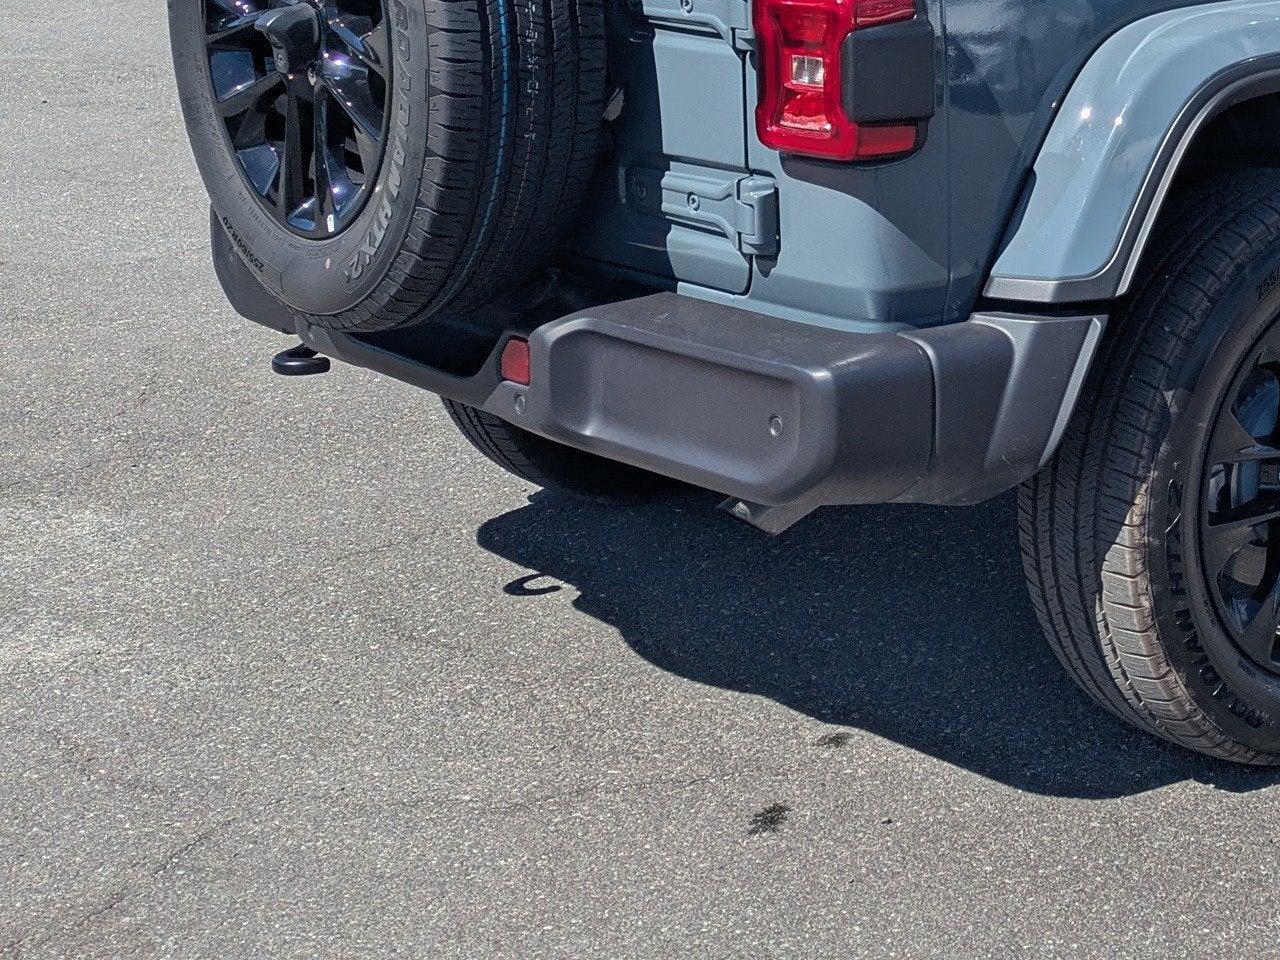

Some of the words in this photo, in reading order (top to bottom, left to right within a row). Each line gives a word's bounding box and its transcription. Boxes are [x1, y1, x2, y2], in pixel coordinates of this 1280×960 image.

[222, 216, 266, 274] 255/60R20
[347, 194, 394, 282] HTX2
[1175, 608, 1264, 729] ROADIAN
